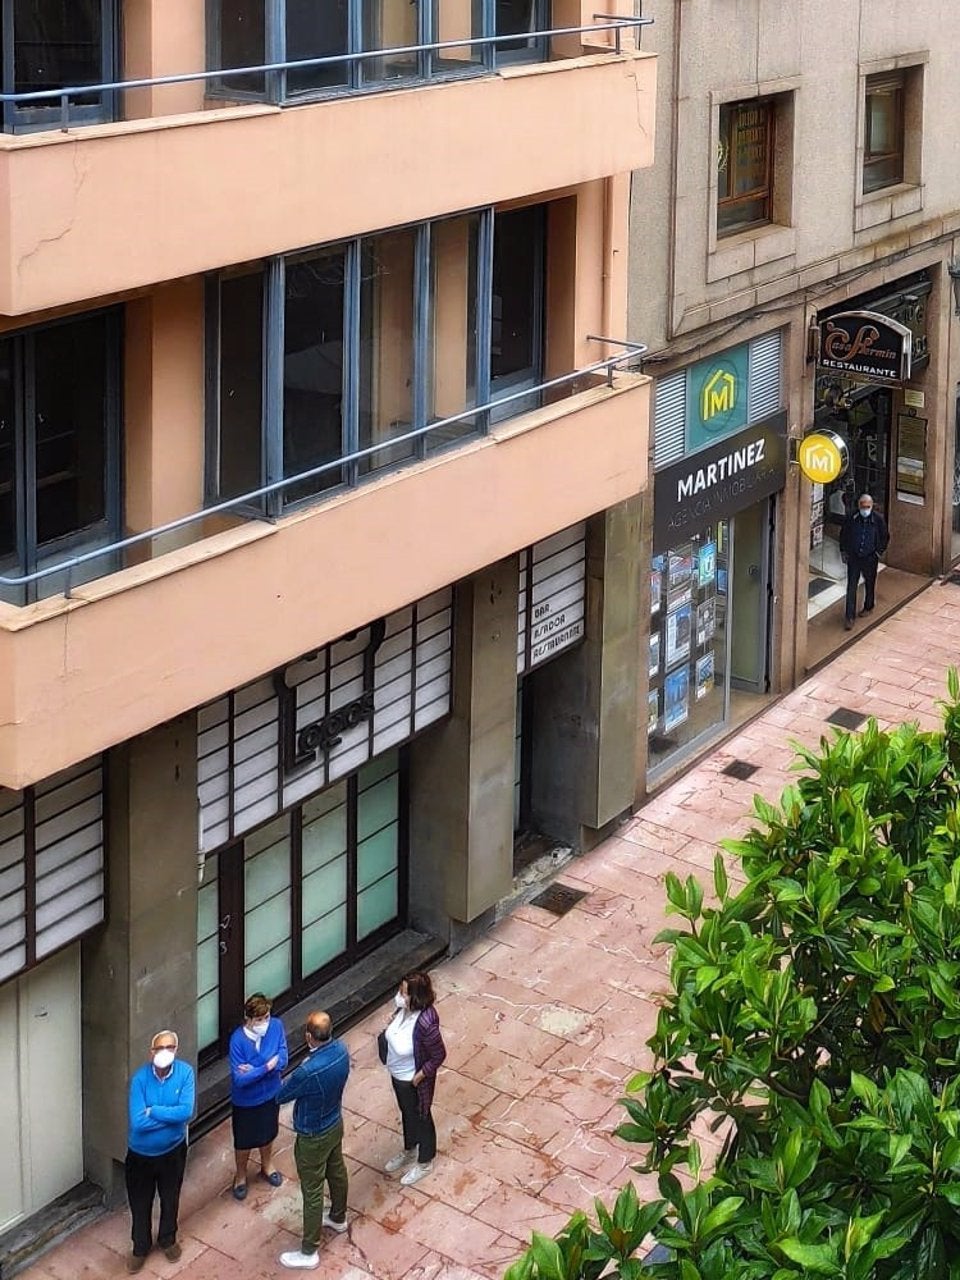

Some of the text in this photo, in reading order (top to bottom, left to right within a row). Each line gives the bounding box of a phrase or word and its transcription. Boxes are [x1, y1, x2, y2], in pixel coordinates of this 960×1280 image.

[822, 358, 897, 378] RESTAURANTE
[677, 437, 765, 503] MARTINEZ
[534, 614, 566, 639] ASADOR
